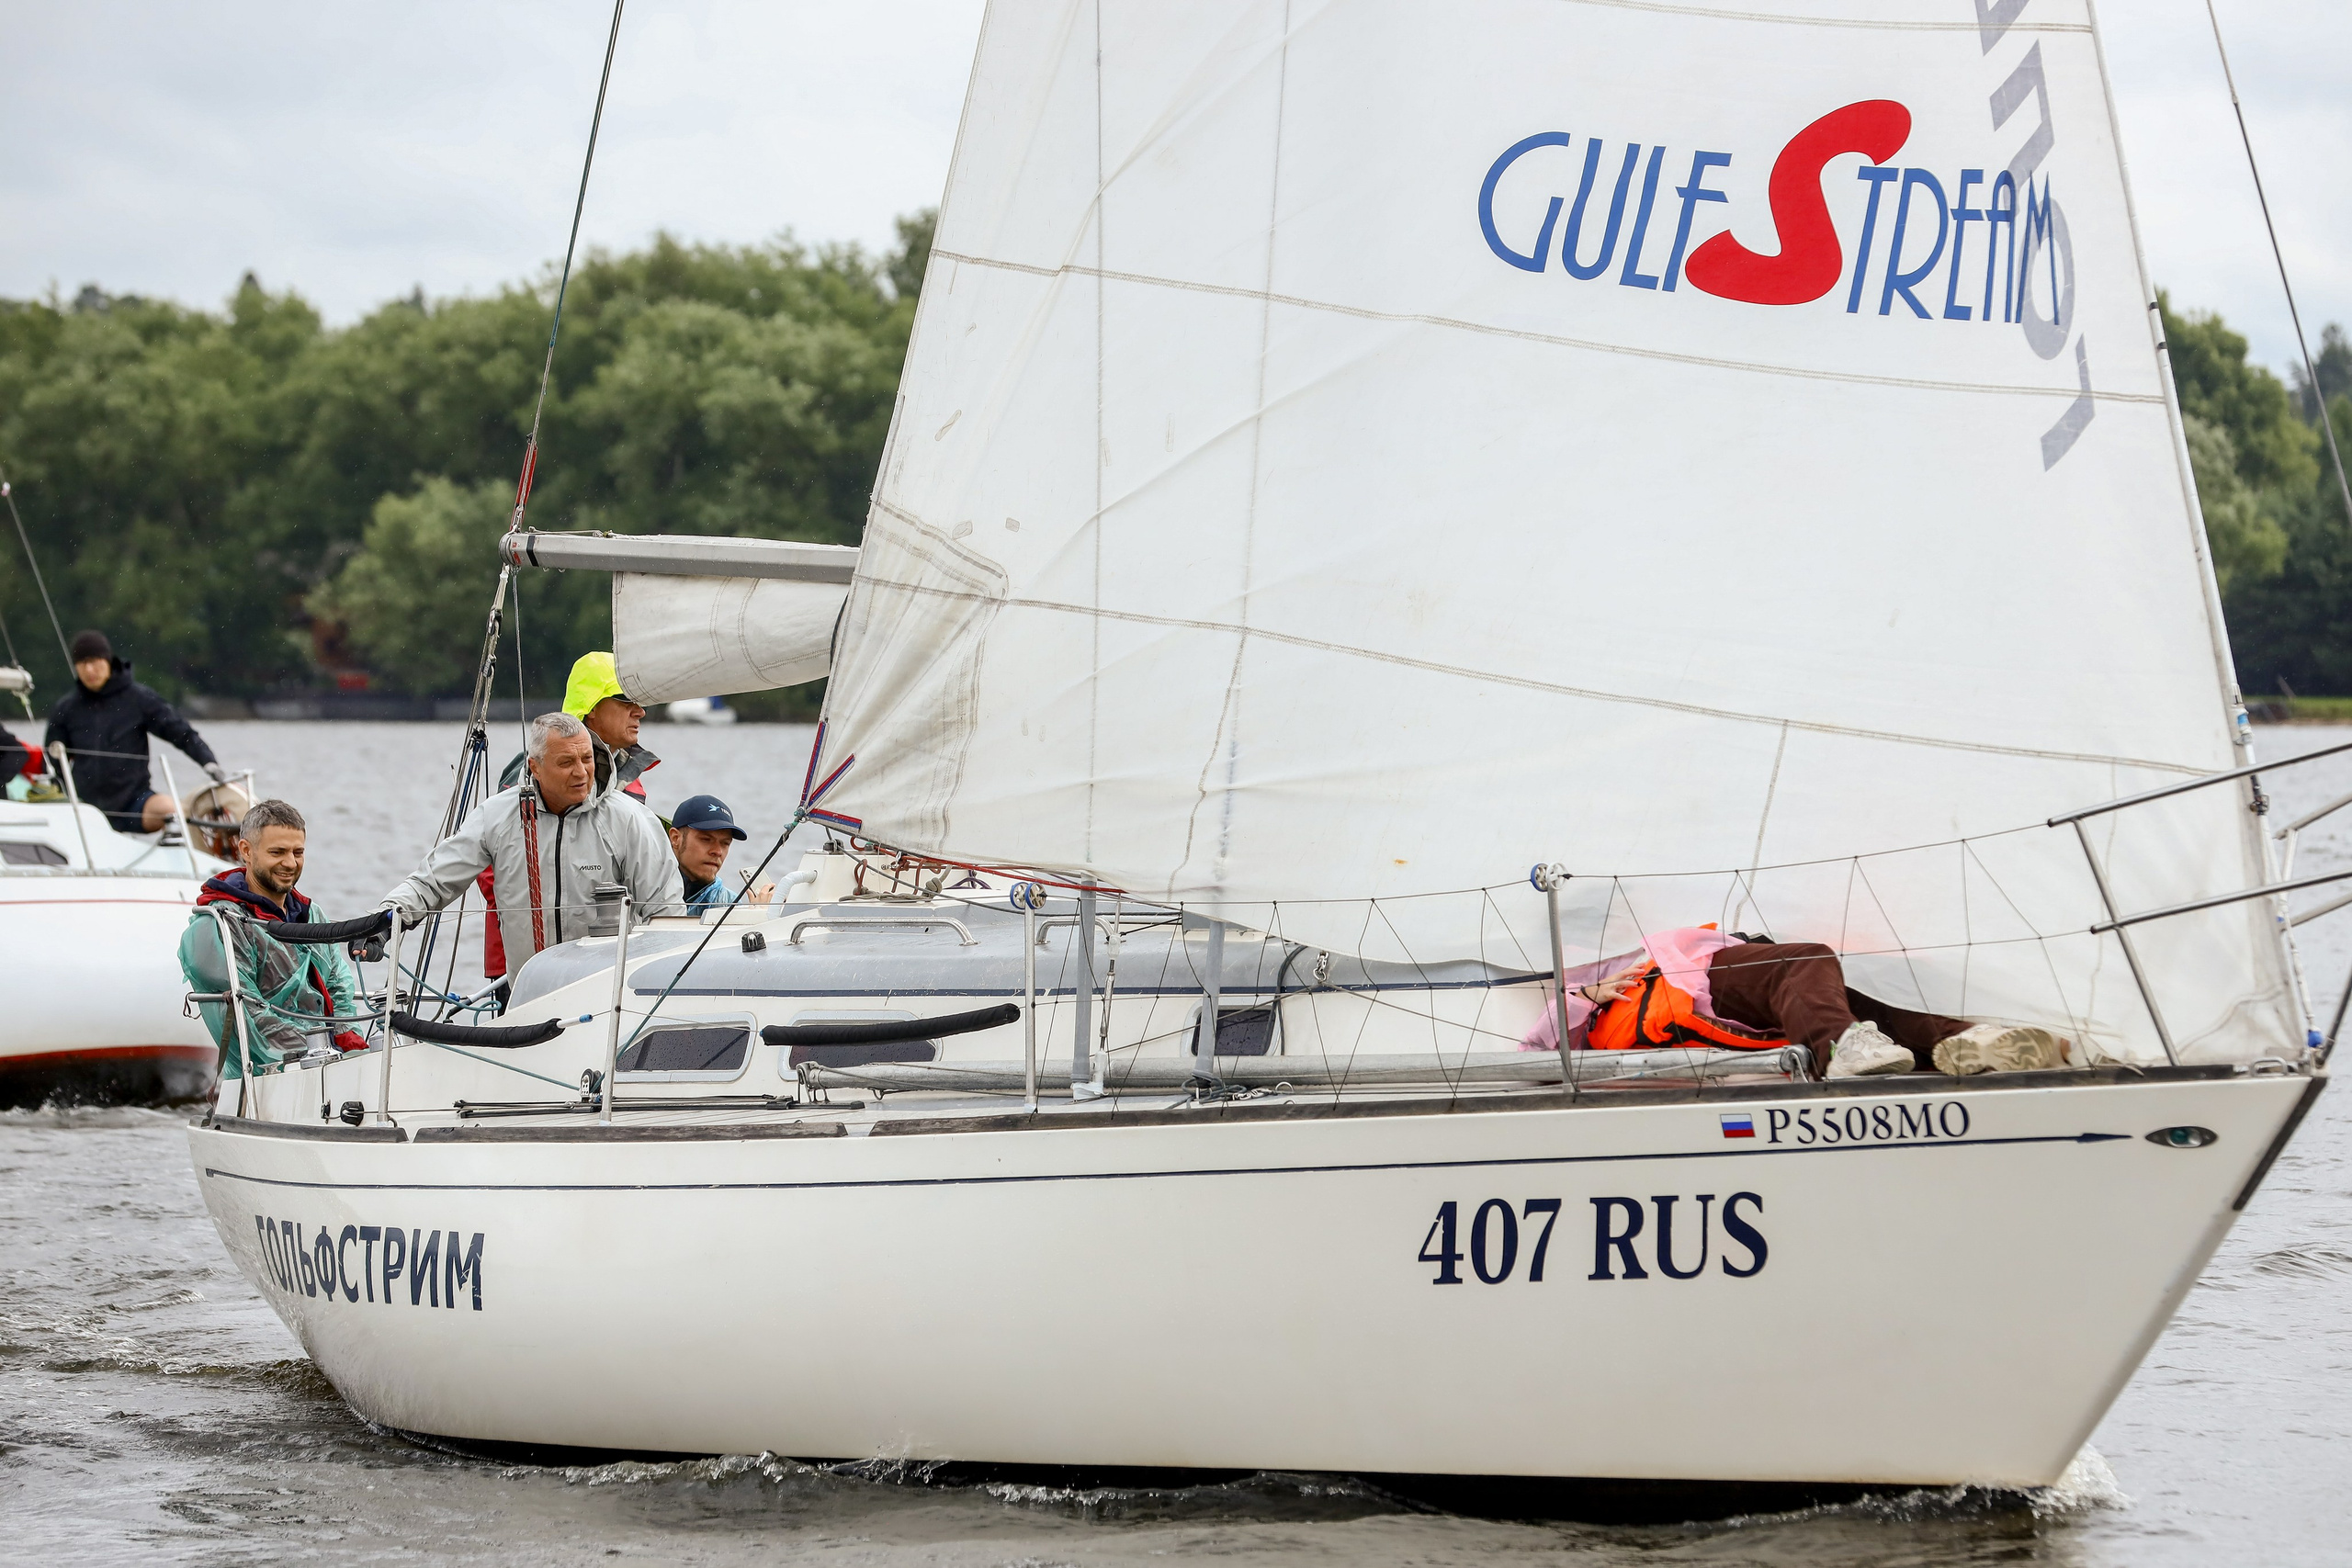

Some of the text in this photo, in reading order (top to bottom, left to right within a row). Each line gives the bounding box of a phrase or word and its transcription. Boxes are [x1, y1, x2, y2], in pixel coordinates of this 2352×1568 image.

[254, 1214, 485, 1311] ГОЛЬФСТРИМ
[1418, 1191, 1770, 1285] 407 RUS
